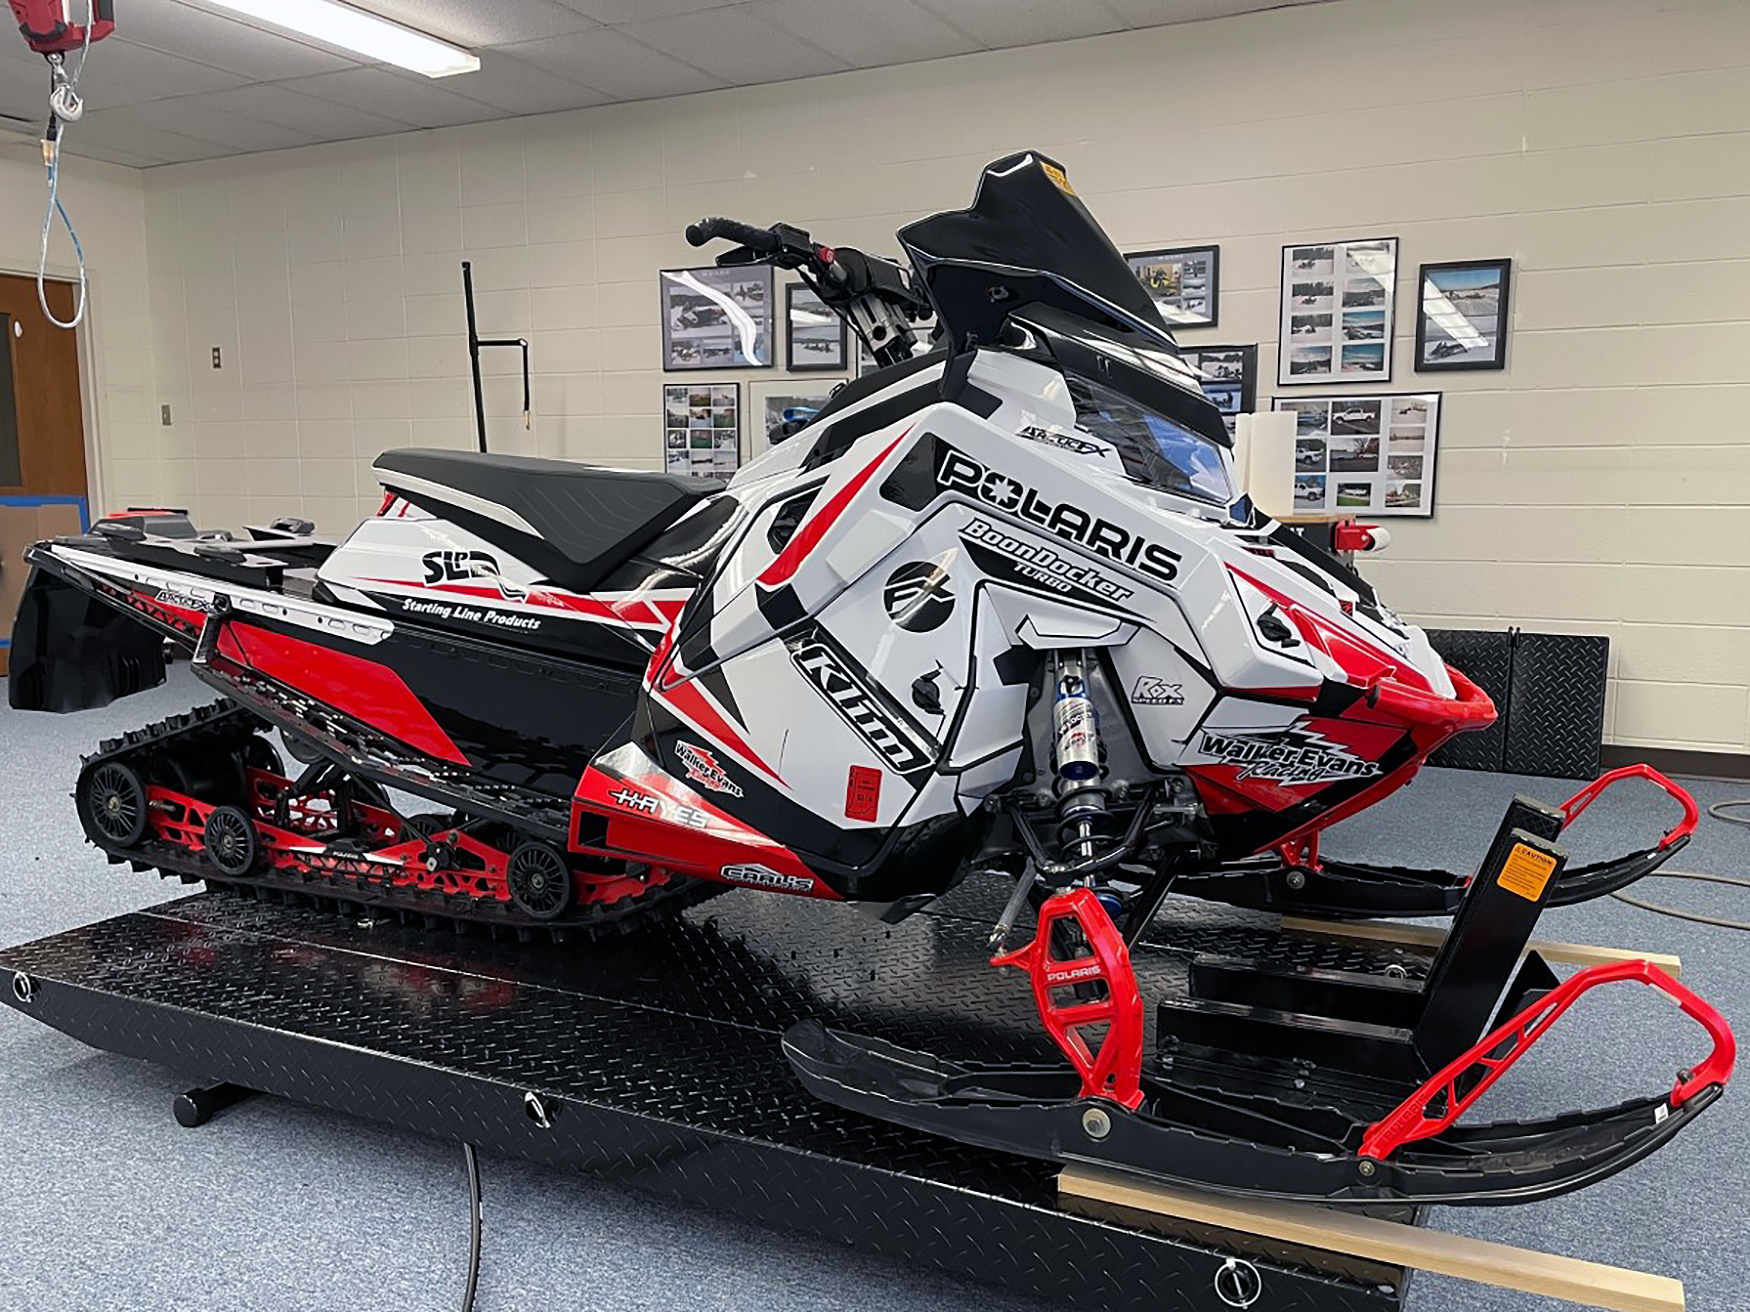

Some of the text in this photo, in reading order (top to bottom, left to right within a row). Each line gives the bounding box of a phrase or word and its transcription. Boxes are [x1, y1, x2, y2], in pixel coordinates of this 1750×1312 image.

[938, 449, 1183, 582] POLARIS
[1013, 562, 1072, 593] TURBO
[402, 598, 541, 630] Starting Line Products
[676, 742, 742, 797] Walker Evans
[1201, 736, 1380, 778] Walker Evans
[1236, 760, 1326, 782] Racing
[609, 787, 708, 830] HAYES
[1521, 848, 1553, 866] CAUTION
[1046, 965, 1101, 981] POLARIS
